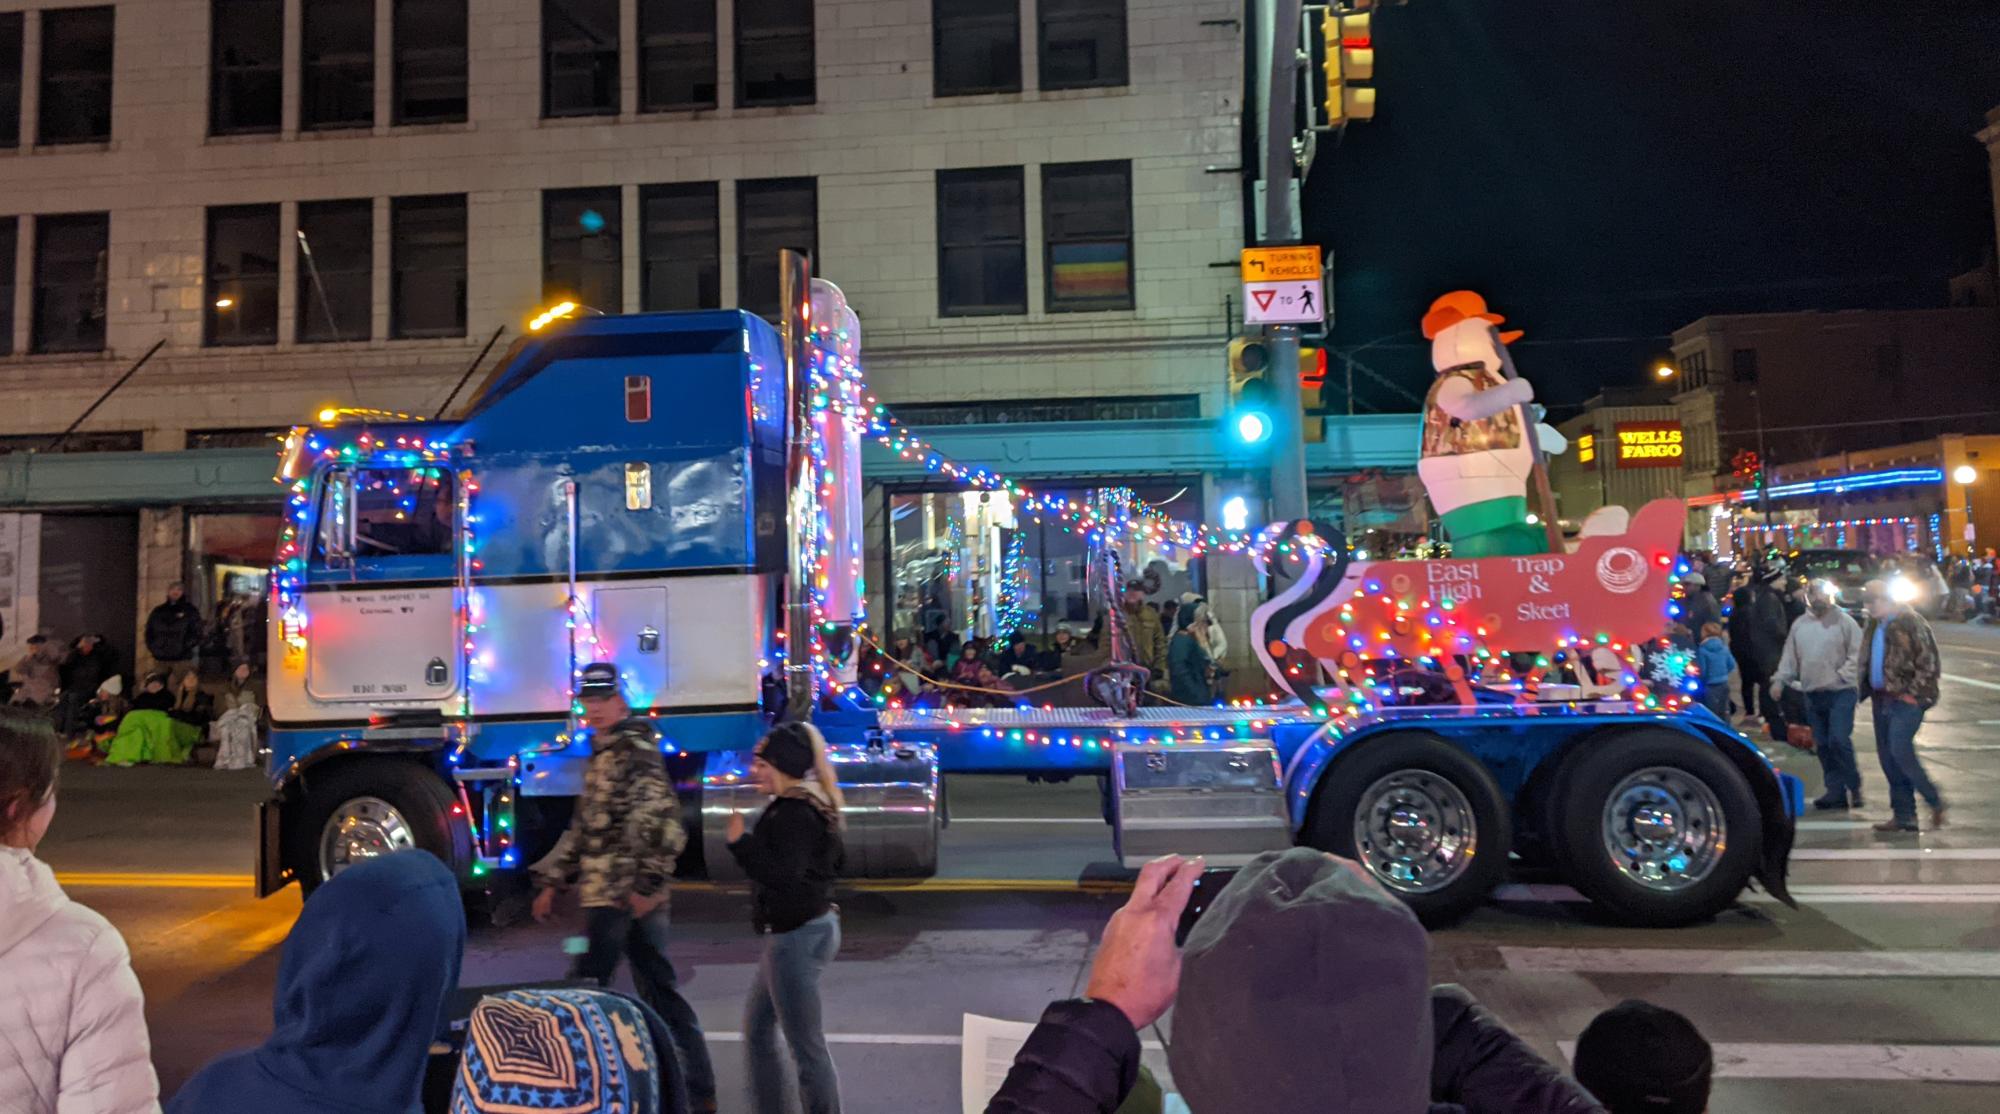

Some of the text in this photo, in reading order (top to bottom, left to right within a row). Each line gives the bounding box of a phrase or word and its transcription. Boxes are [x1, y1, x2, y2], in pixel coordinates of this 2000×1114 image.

[1269, 252, 1314, 262] TURNING
[1269, 265, 1314, 275] VEHICLES
[1280, 296, 1293, 305] TO
[1618, 430, 1682, 444] WELLS
[1622, 444, 1683, 458] FARGO
[1426, 561, 1480, 583] East
[1511, 557, 1565, 575] Trap
[1528, 574, 1552, 594] &
[1428, 581, 1483, 604] High
[1517, 602, 1570, 621] Skeet
